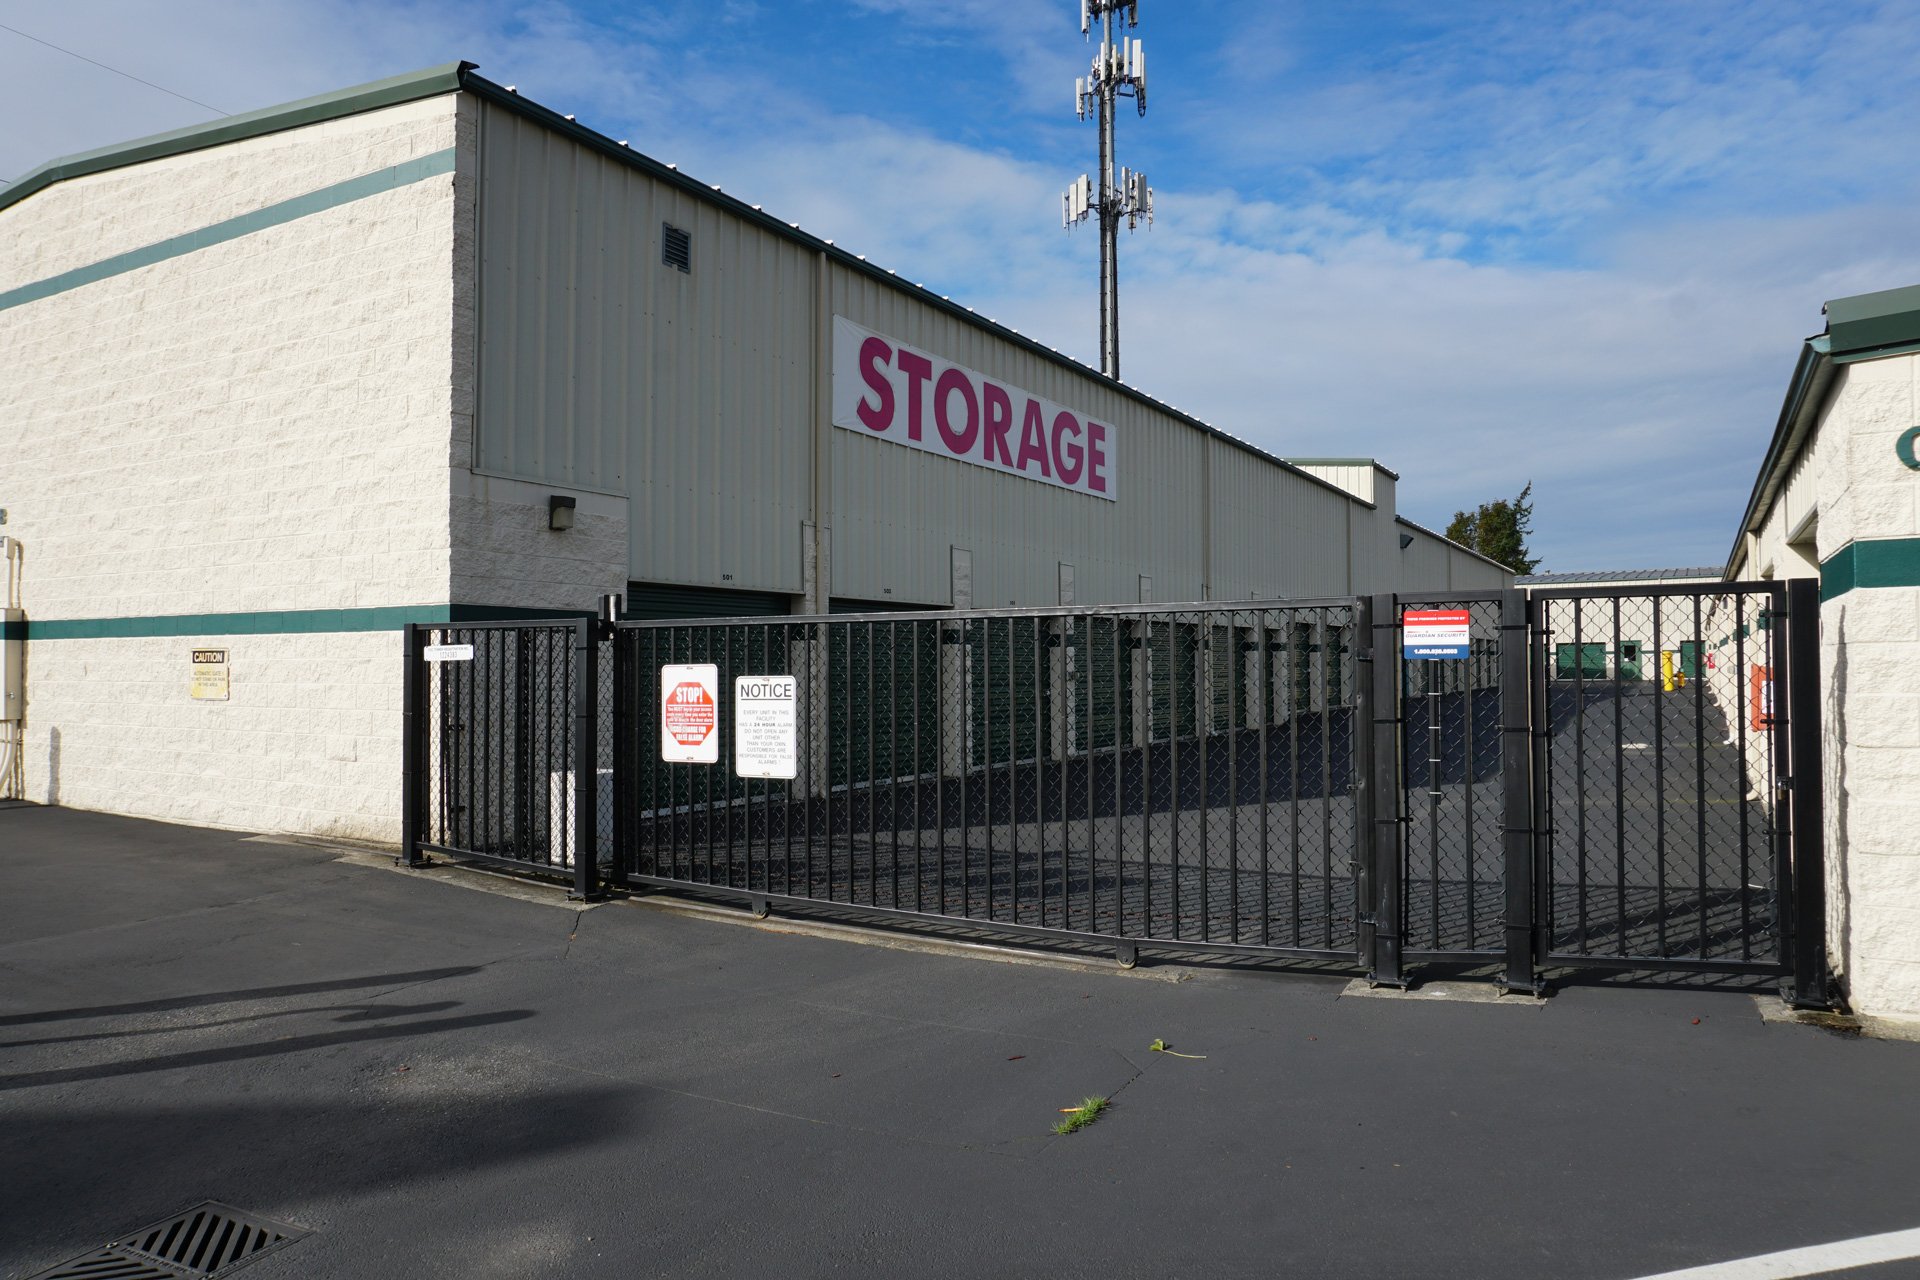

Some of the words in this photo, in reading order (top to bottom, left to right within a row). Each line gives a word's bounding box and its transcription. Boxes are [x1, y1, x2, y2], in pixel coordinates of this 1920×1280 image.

[857, 337, 1106, 493] STORAGE
[194, 652, 222, 662] CAUTION
[676, 687, 703, 703] STOP!
[741, 684, 792, 698] NOTICE
